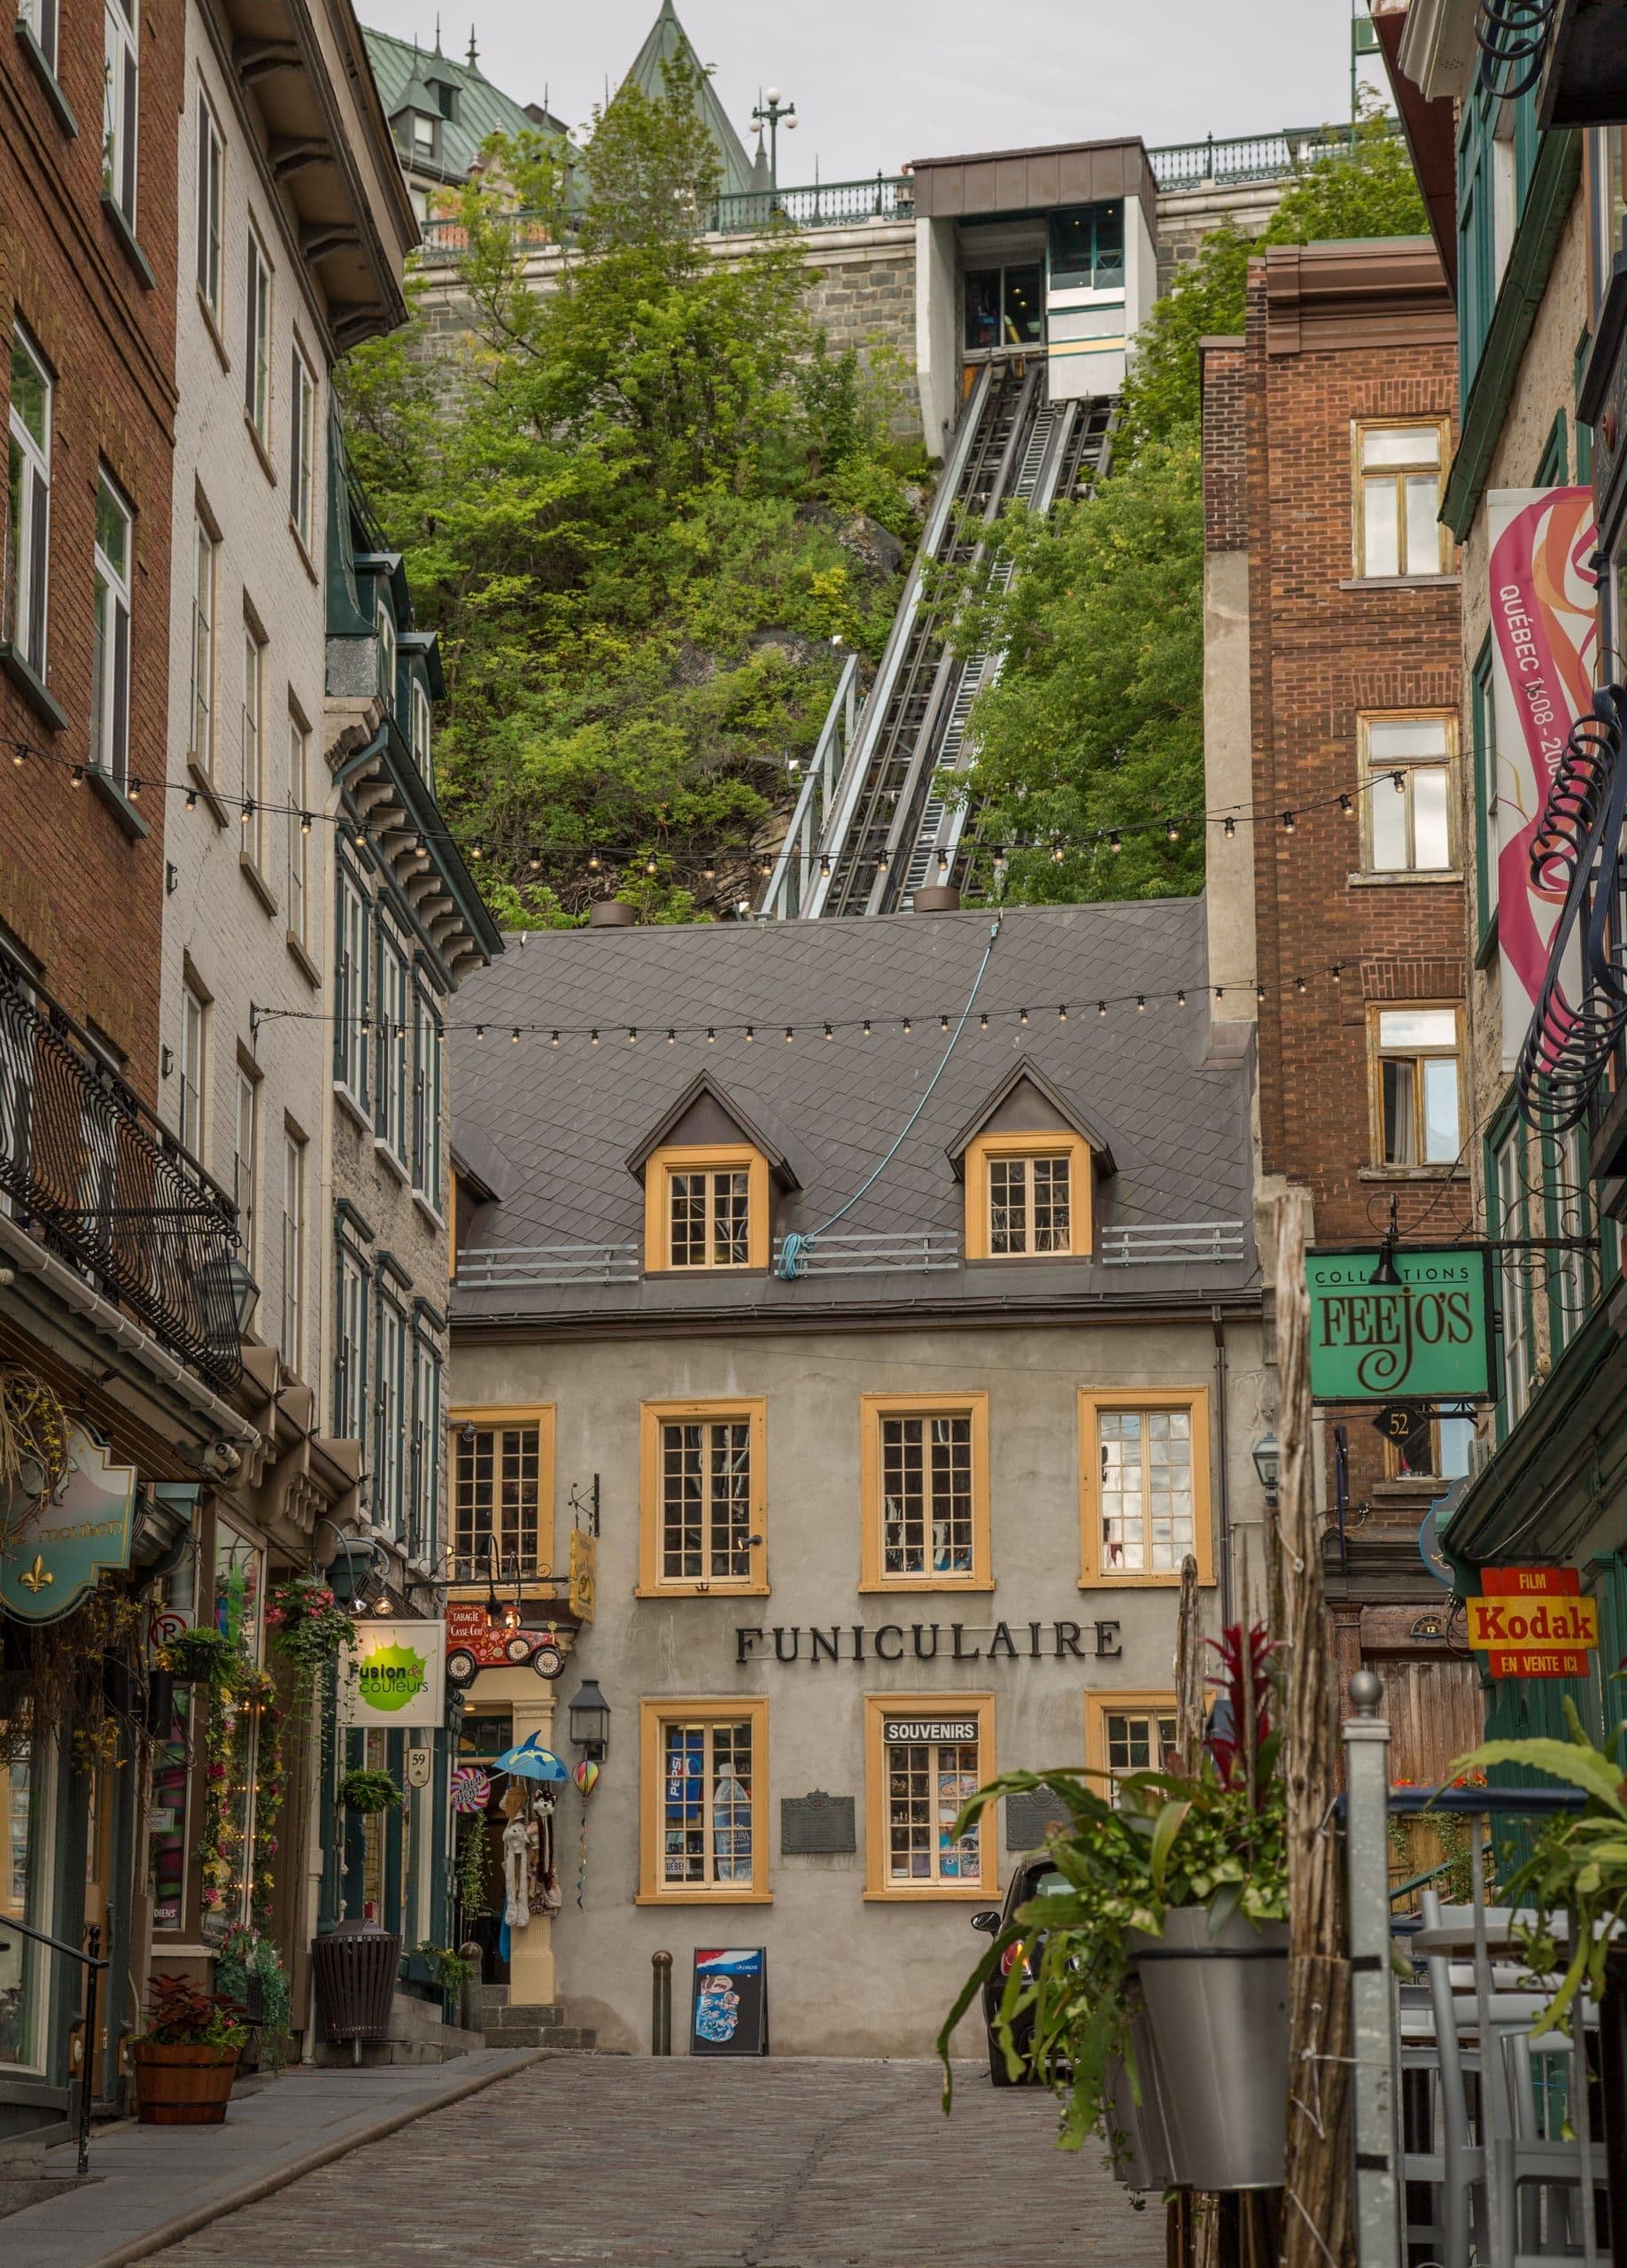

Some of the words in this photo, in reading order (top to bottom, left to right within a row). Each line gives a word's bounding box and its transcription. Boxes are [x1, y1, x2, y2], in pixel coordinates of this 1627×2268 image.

[1499, 585, 1539, 672] QUÉBEC
[1525, 678, 1553, 725] 1608
[1540, 737, 1569, 788] 200
[1315, 1268, 1468, 1283] COLLTIONS
[1389, 1413, 1408, 1434] 52
[1519, 1574, 1546, 1588] FILM
[1475, 1606, 1593, 1640] Kodak
[735, 1620, 1122, 1663] FUNICULAIRE
[350, 1664, 406, 1679] Fusion
[407, 1664, 422, 1679] &
[1501, 1657, 1517, 1672] EN
[1523, 1657, 1559, 1672] VENTE
[1564, 1656, 1577, 1672] ICI
[360, 1680, 429, 1693] couleurs
[888, 1724, 974, 1739] SOUVENIRS
[412, 1754, 425, 1766] 59
[670, 1756, 682, 1797] PEPSI
